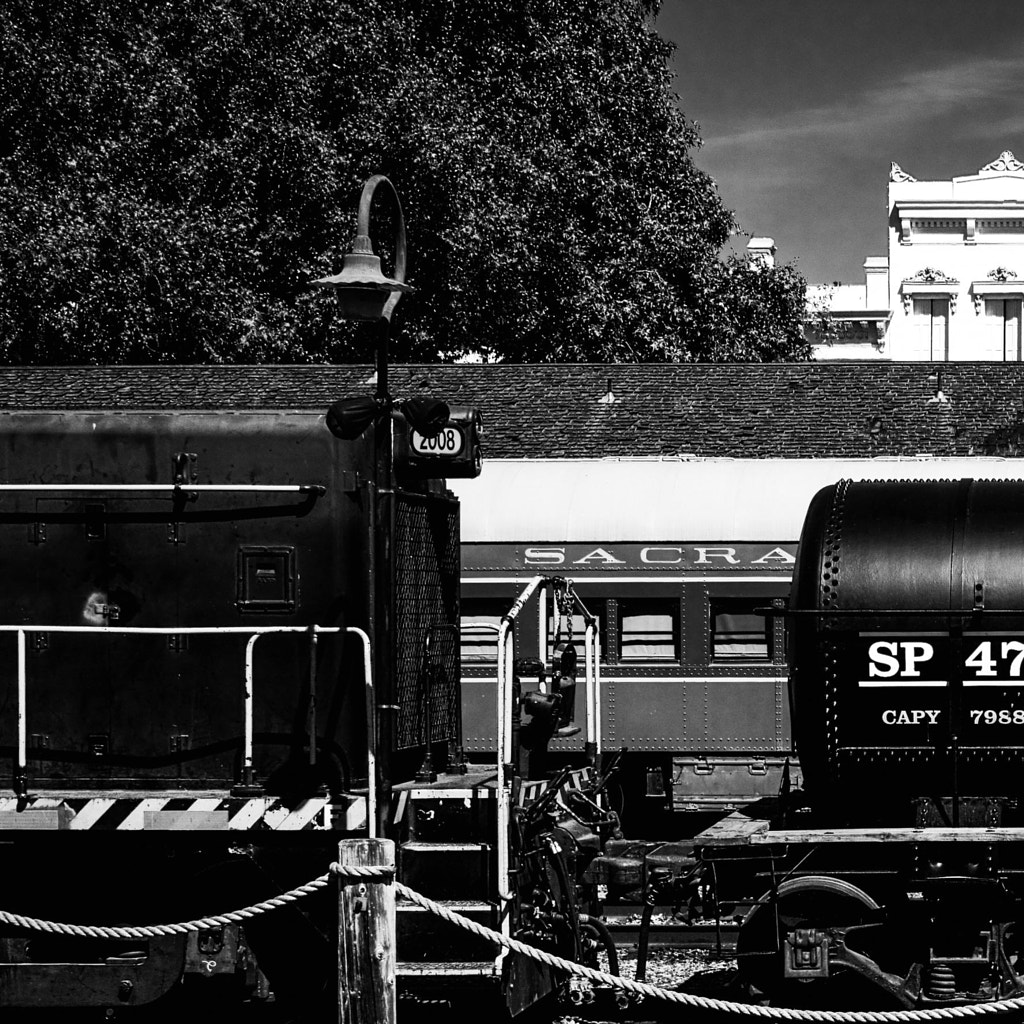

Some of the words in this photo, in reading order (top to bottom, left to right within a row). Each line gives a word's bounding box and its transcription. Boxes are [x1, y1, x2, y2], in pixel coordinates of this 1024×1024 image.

[420, 430, 455, 451] 2008
[869, 642, 933, 677] SP
[882, 710, 941, 724] CAPY
